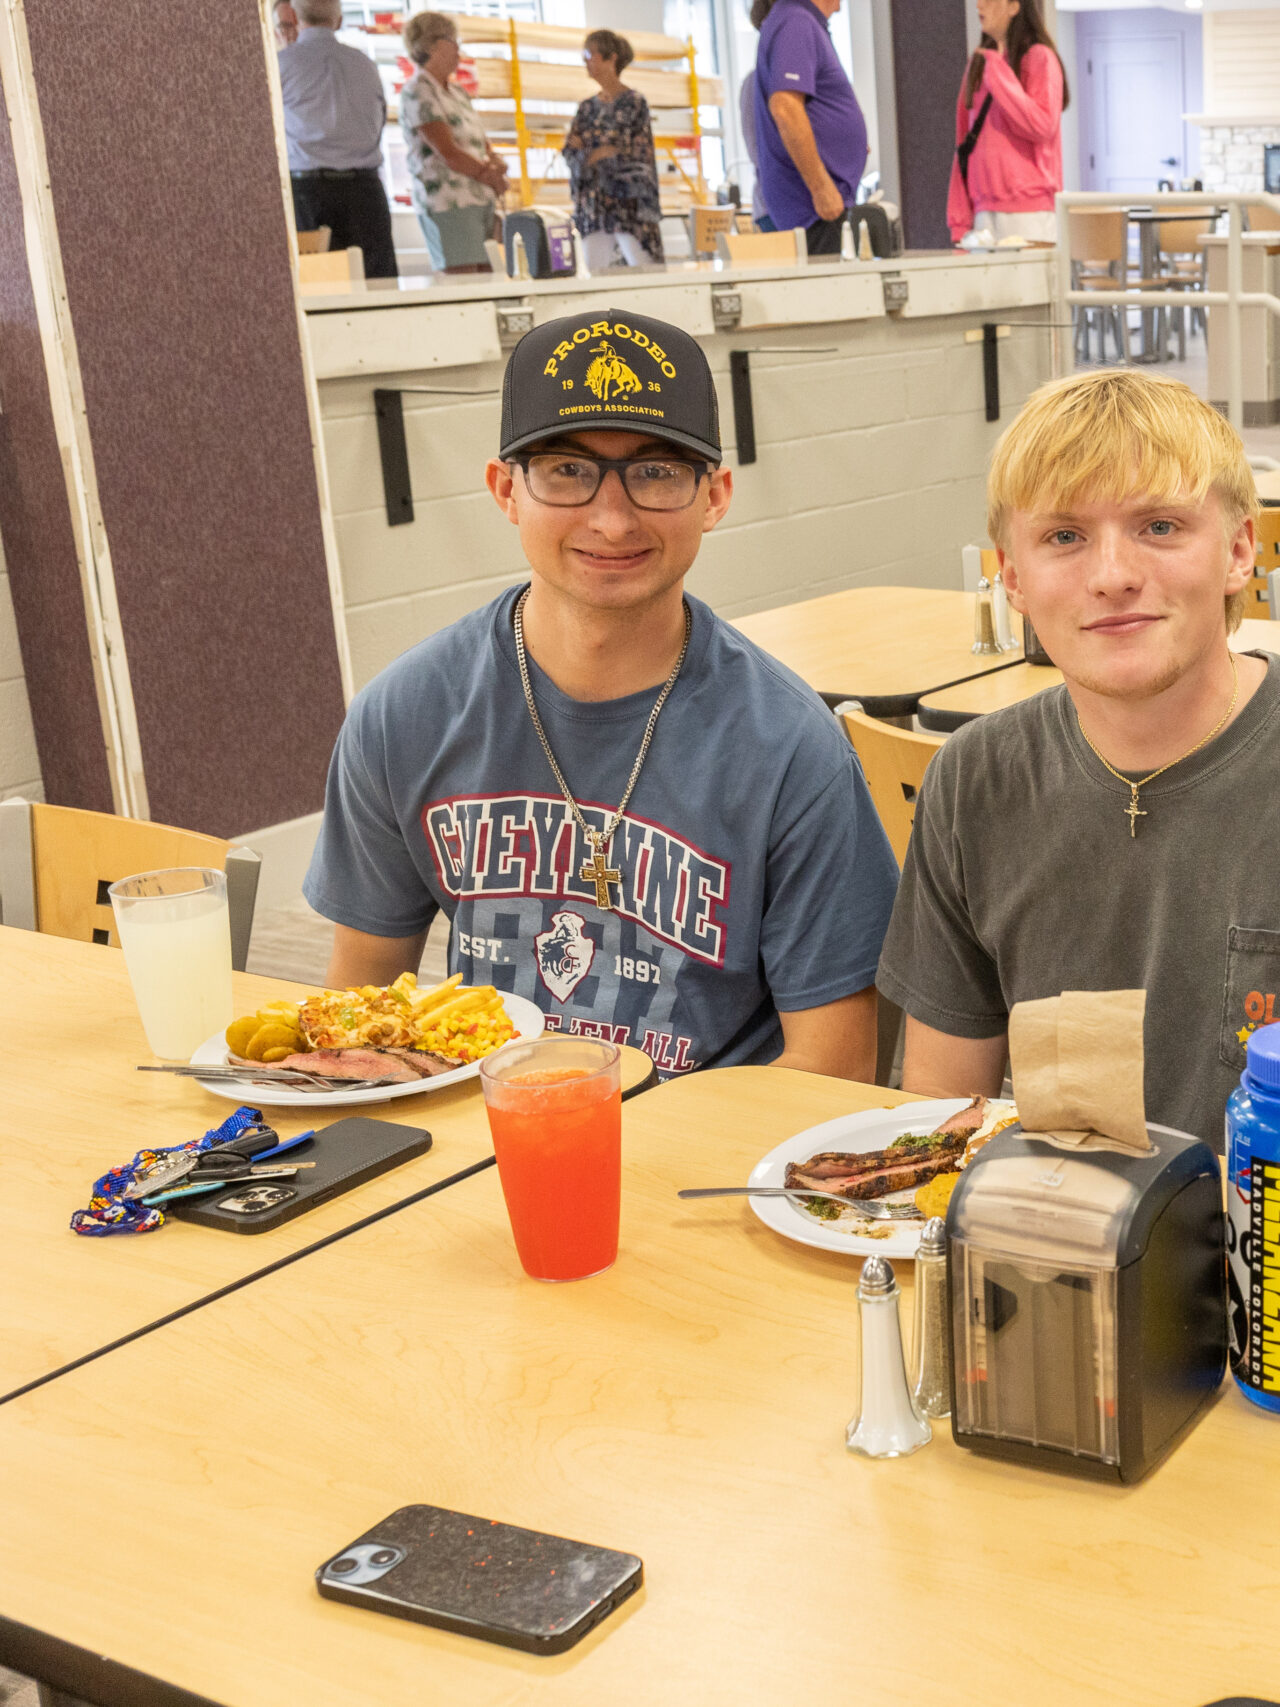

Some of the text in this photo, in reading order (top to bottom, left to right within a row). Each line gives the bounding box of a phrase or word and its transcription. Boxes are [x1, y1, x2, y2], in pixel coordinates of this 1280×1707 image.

[543, 320, 677, 379] PRORODEO
[561, 379, 661, 393] 19 36
[558, 404, 665, 418] COWBOYS ASSOCIATION
[458, 931, 662, 985] EST. 1897
[640, 1029, 695, 1073] ALL
[1251, 1163, 1263, 1386] LEADVILLE COLORADO
